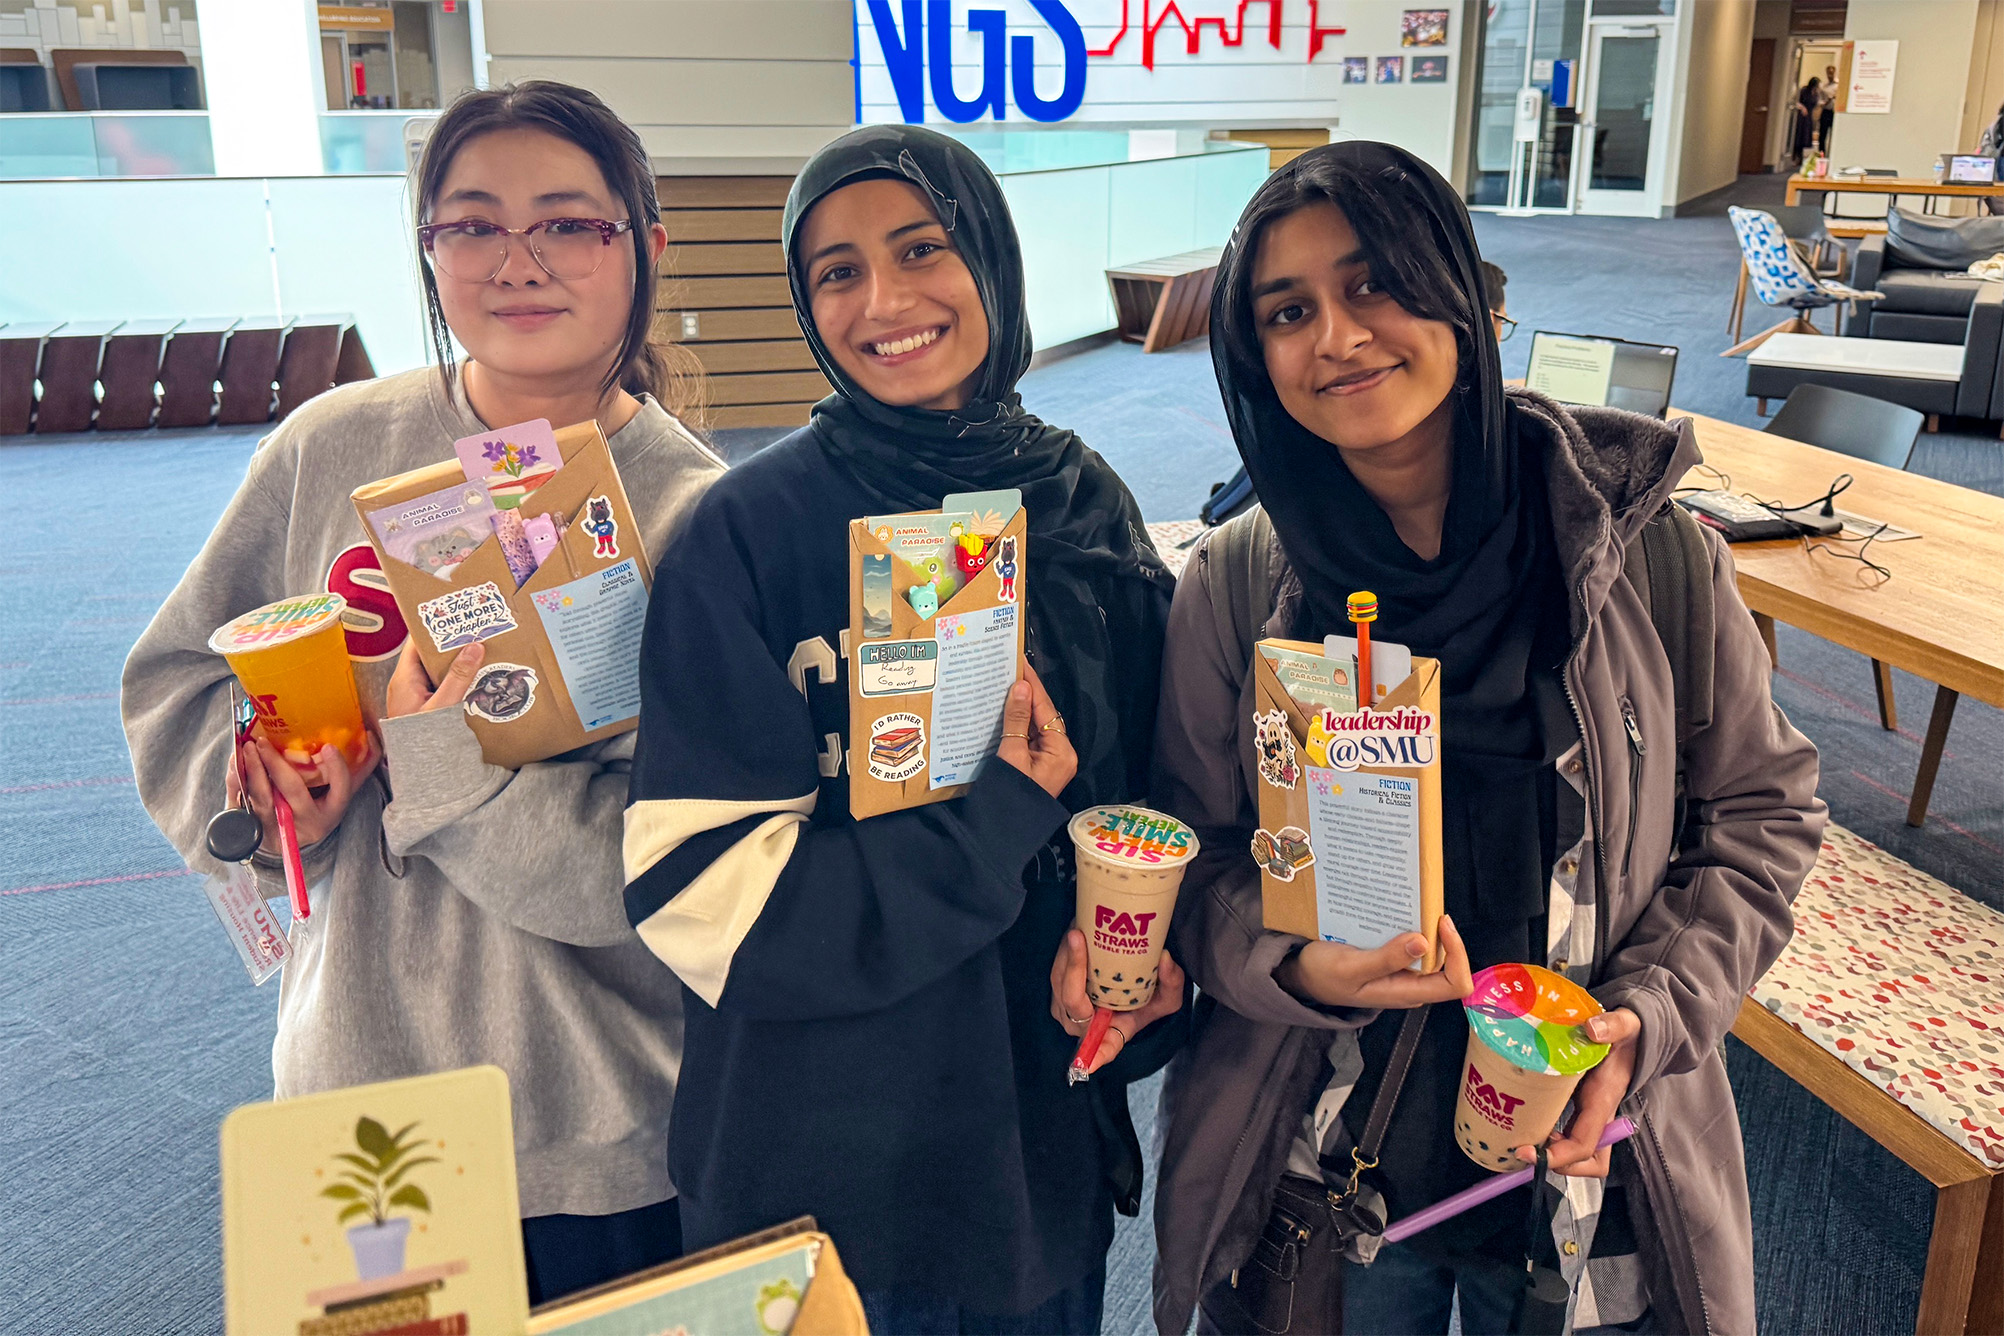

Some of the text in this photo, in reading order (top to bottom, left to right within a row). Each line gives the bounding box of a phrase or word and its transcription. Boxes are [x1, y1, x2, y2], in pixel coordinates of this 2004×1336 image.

[402, 503, 440, 519] ANIMAL
[413, 507, 463, 526] PARADISE
[901, 537, 945, 546] PARADISE
[602, 562, 631, 579] FICTION
[448, 596, 475, 613] Just
[993, 606, 1014, 618] FICTION
[437, 603, 498, 629] ONE MORE
[870, 645, 907, 661] HELLO
[881, 661, 916, 676] Reading
[1281, 660, 1309, 670] ANIMAL
[878, 675, 917, 688] Go away
[1290, 671, 1328, 684] PARADISE
[886, 714, 921, 726] RATHER
[1325, 710, 1431, 735] leadership
[1330, 735, 1434, 769] @SMU
[870, 765, 882, 777] BE
[884, 759, 925, 779] READING
[1379, 779, 1411, 791] FICTION
[1095, 904, 1157, 936] FAT
[1093, 941, 1120, 954] BUBBLE
[1538, 985, 1560, 1002] IN
[1565, 1008, 1579, 1017] A
[1468, 1062, 1525, 1114] FAT
